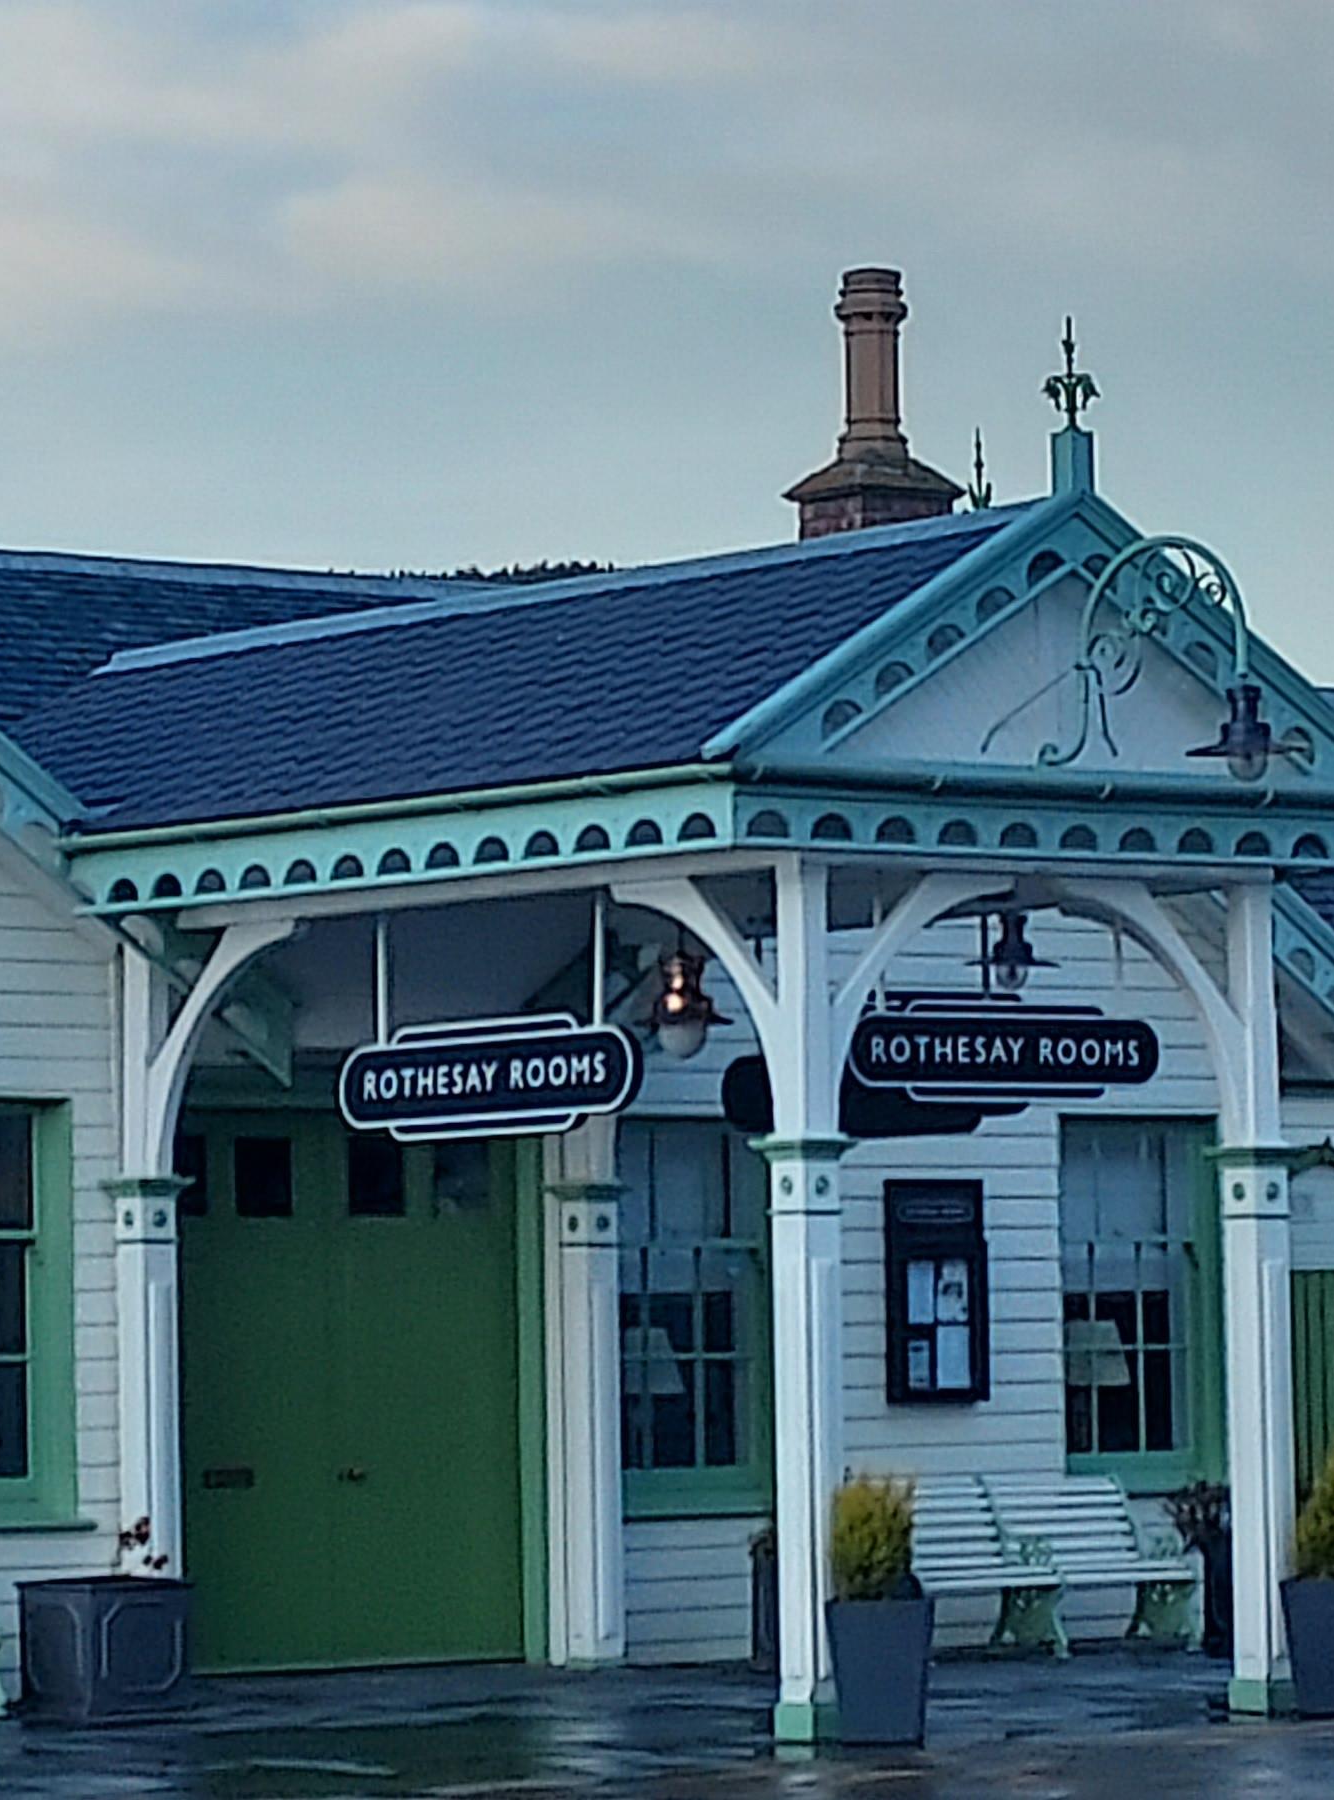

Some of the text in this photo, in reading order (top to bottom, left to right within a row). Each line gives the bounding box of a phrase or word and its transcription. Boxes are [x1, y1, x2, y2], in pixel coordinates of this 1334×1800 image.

[870, 1035, 1141, 1067] ROTHESAY ROOMS
[362, 1050, 607, 1101] ROTHESAY ROOMS
